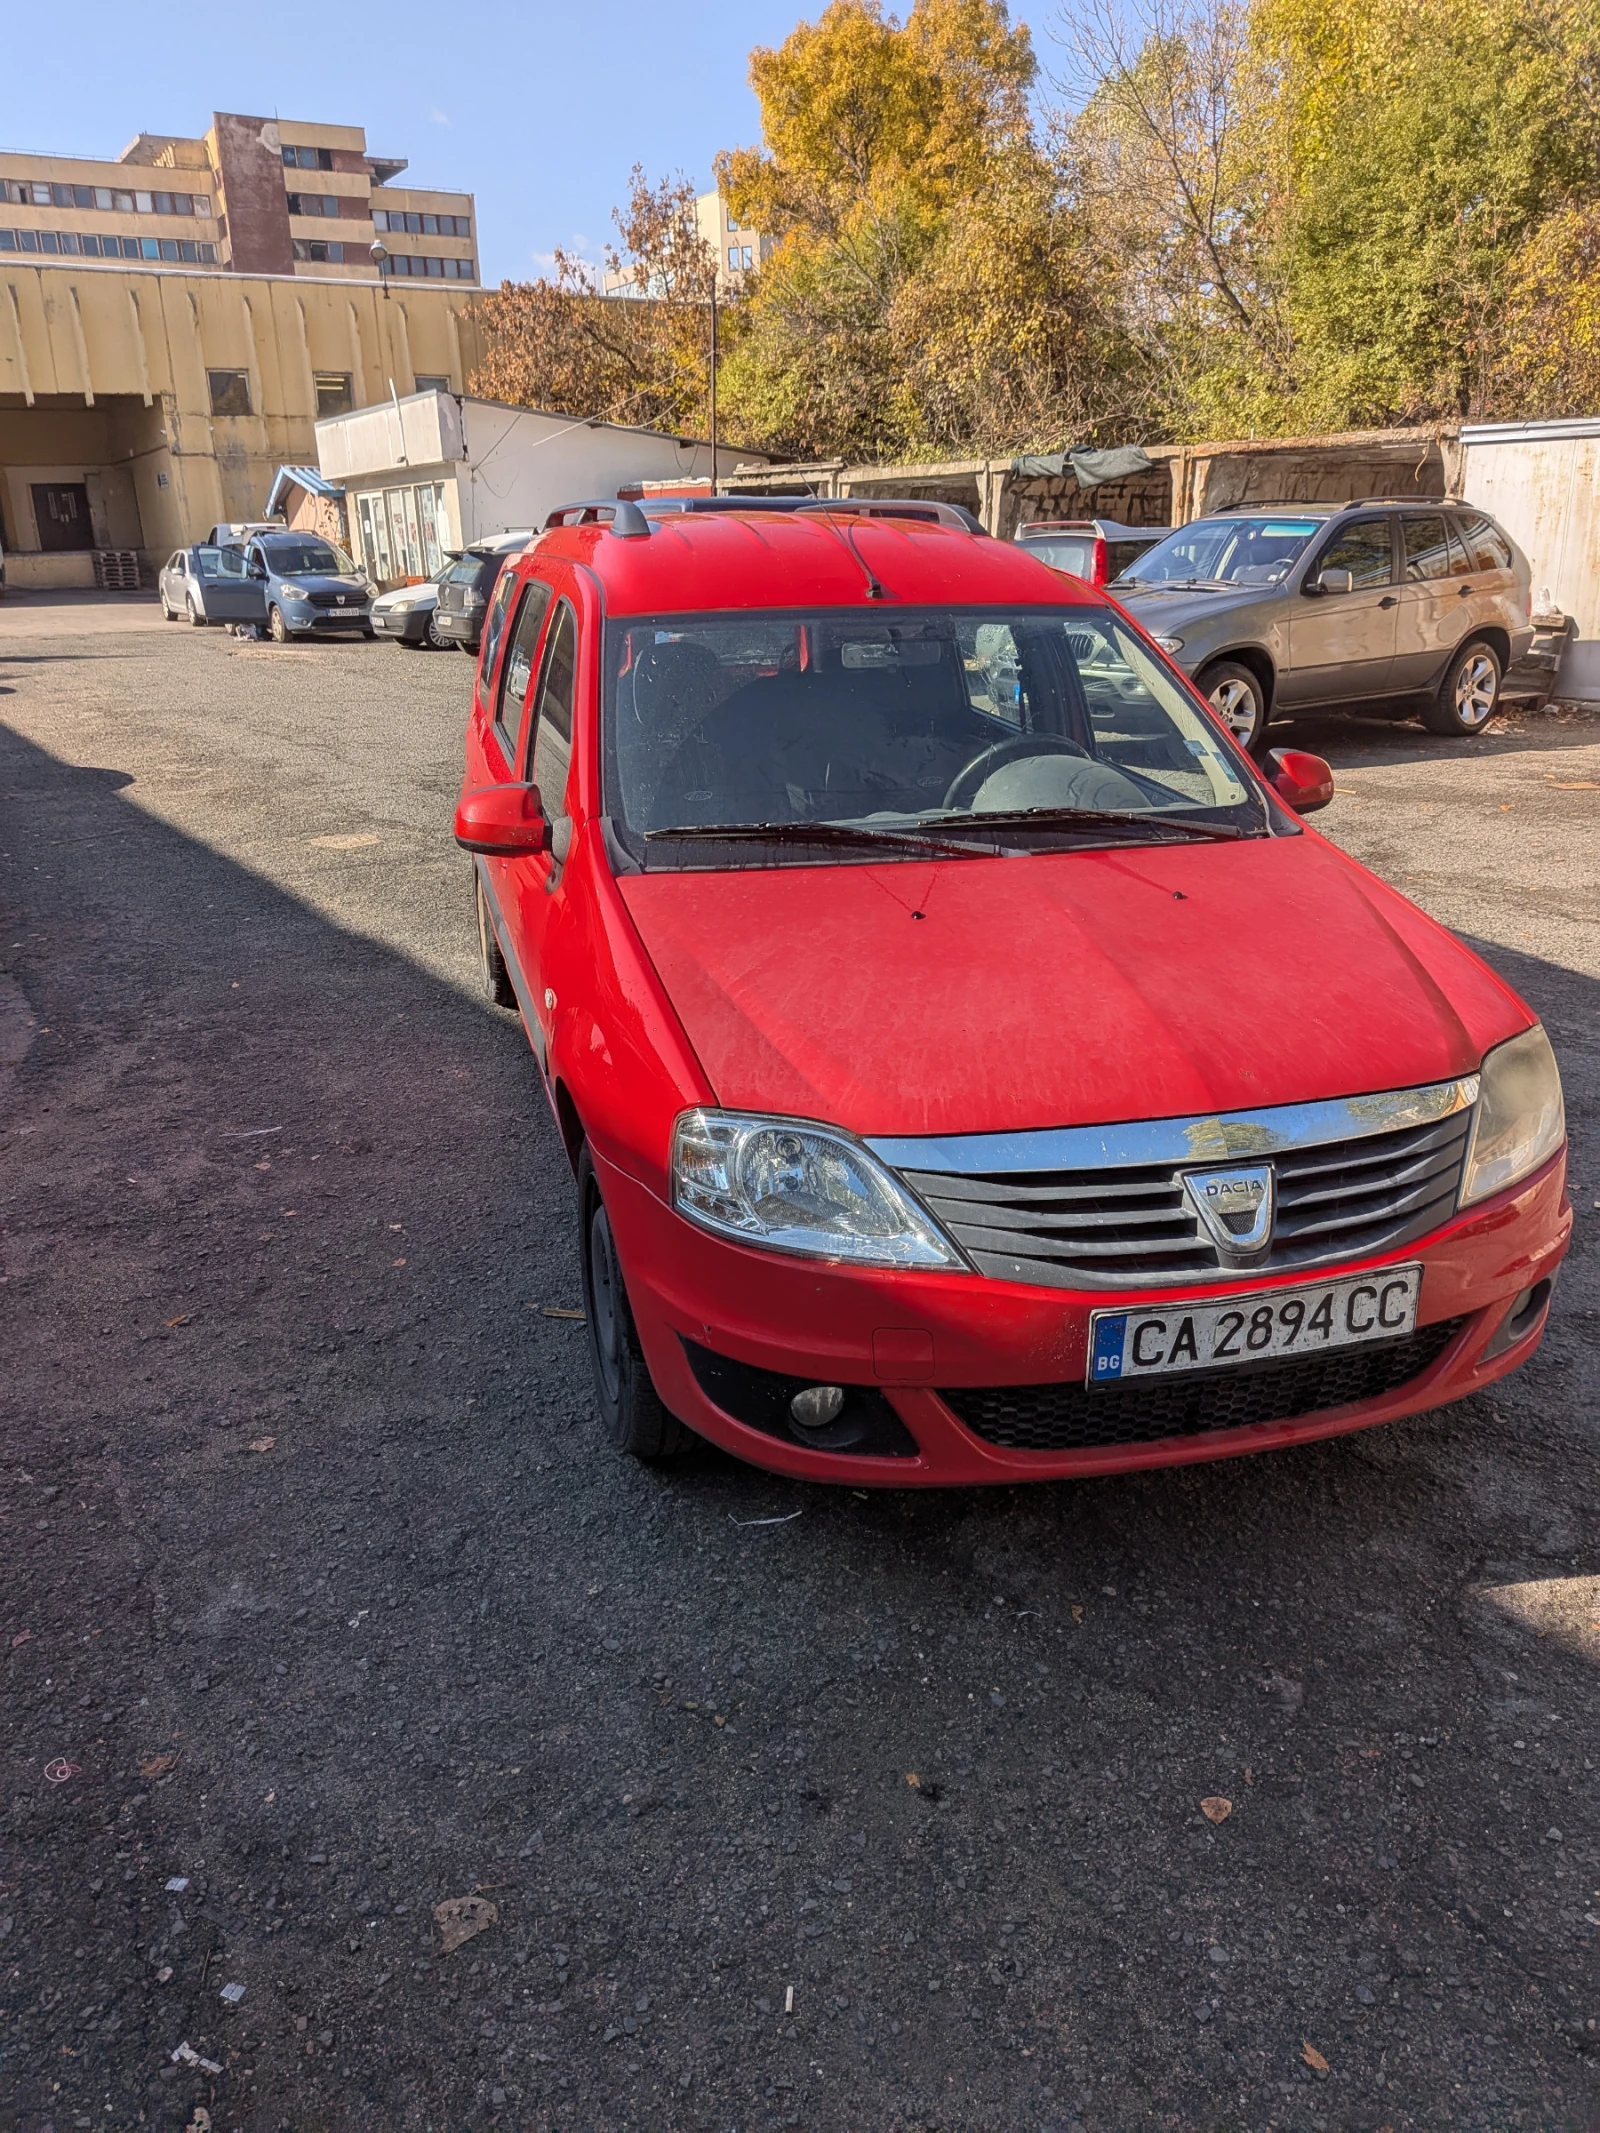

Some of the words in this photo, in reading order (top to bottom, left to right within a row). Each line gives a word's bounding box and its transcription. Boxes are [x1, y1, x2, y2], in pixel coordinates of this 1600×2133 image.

[1205, 1180, 1263, 1197] DACIA
[1132, 1316, 1199, 1367] CA
[1213, 1291, 1334, 1359] 2894
[1346, 1280, 1409, 1333] CC
[1097, 1354, 1120, 1371] BG
